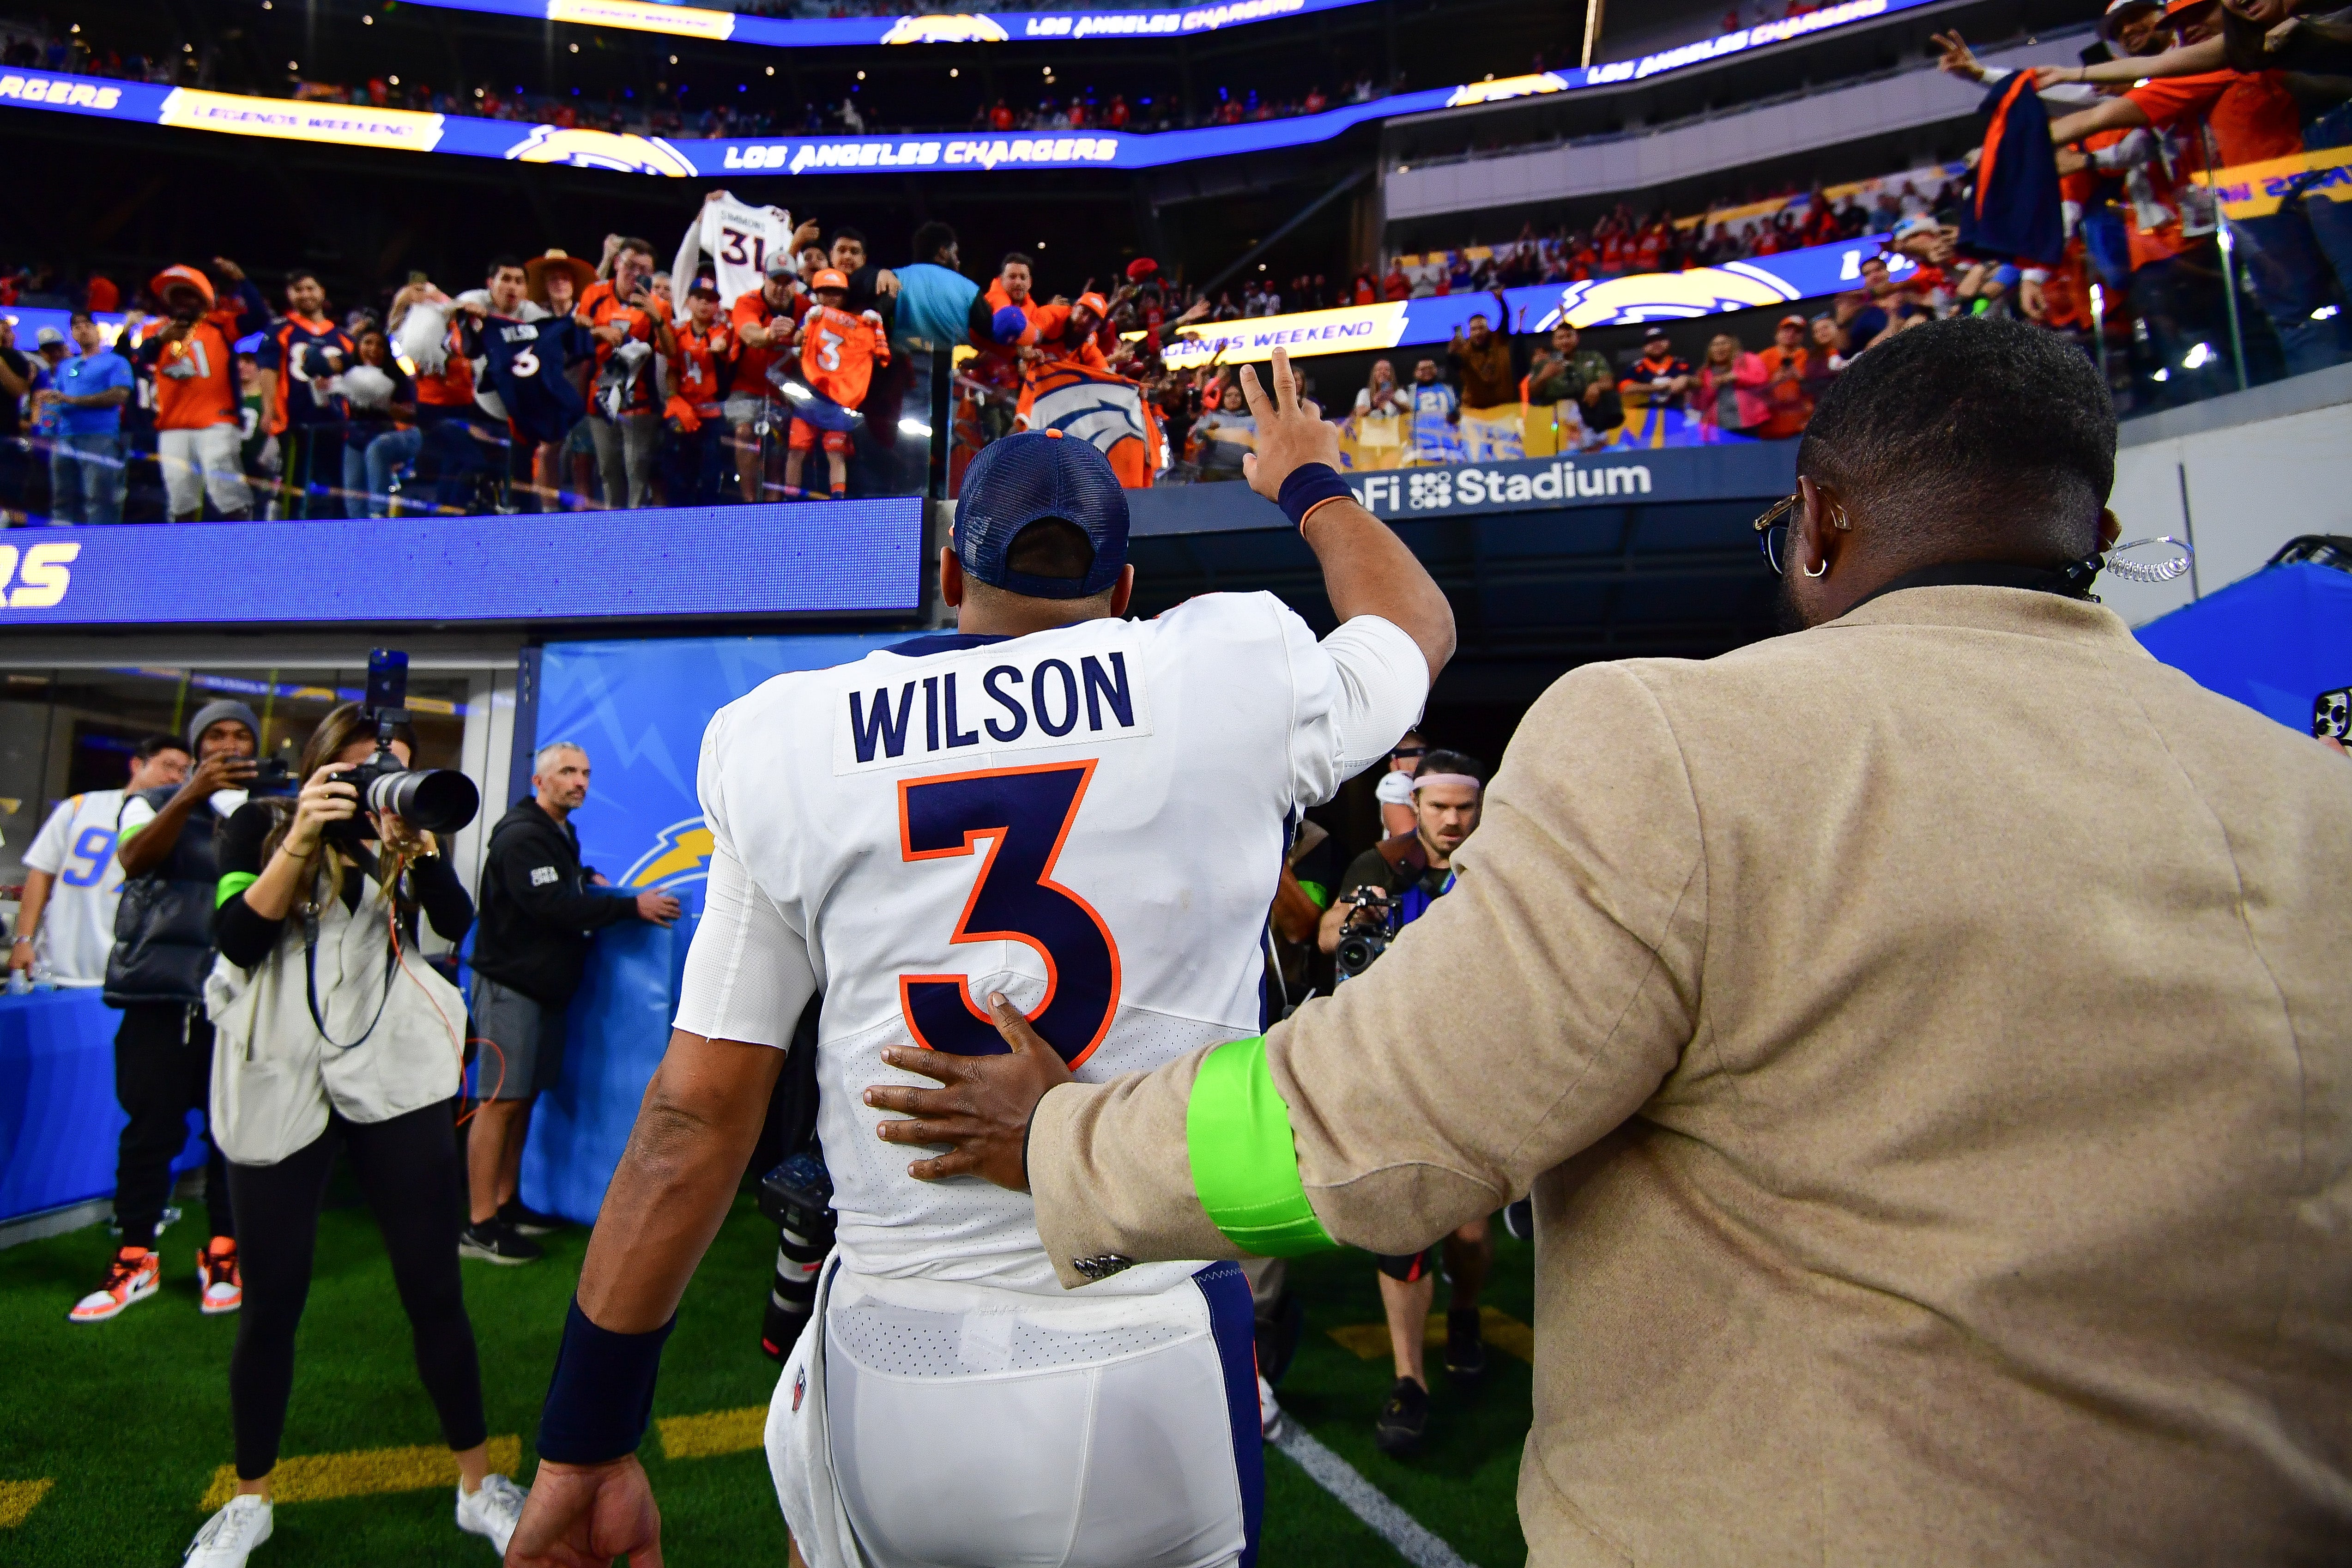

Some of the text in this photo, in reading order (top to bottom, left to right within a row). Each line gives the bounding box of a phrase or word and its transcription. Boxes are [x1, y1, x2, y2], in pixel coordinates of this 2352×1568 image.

[1026, 16, 1072, 36] LOS
[1073, 13, 1181, 39] ANGELES
[723, 139, 1119, 175] LOS ANGELES CHARGERS
[721, 225, 765, 272] 31
[817, 328, 845, 372] 3
[1254, 321, 1374, 347] WEEKEND
[1455, 461, 1652, 506] Stadium
[848, 651, 1135, 763] WILSON
[897, 757, 1122, 1072] 3
